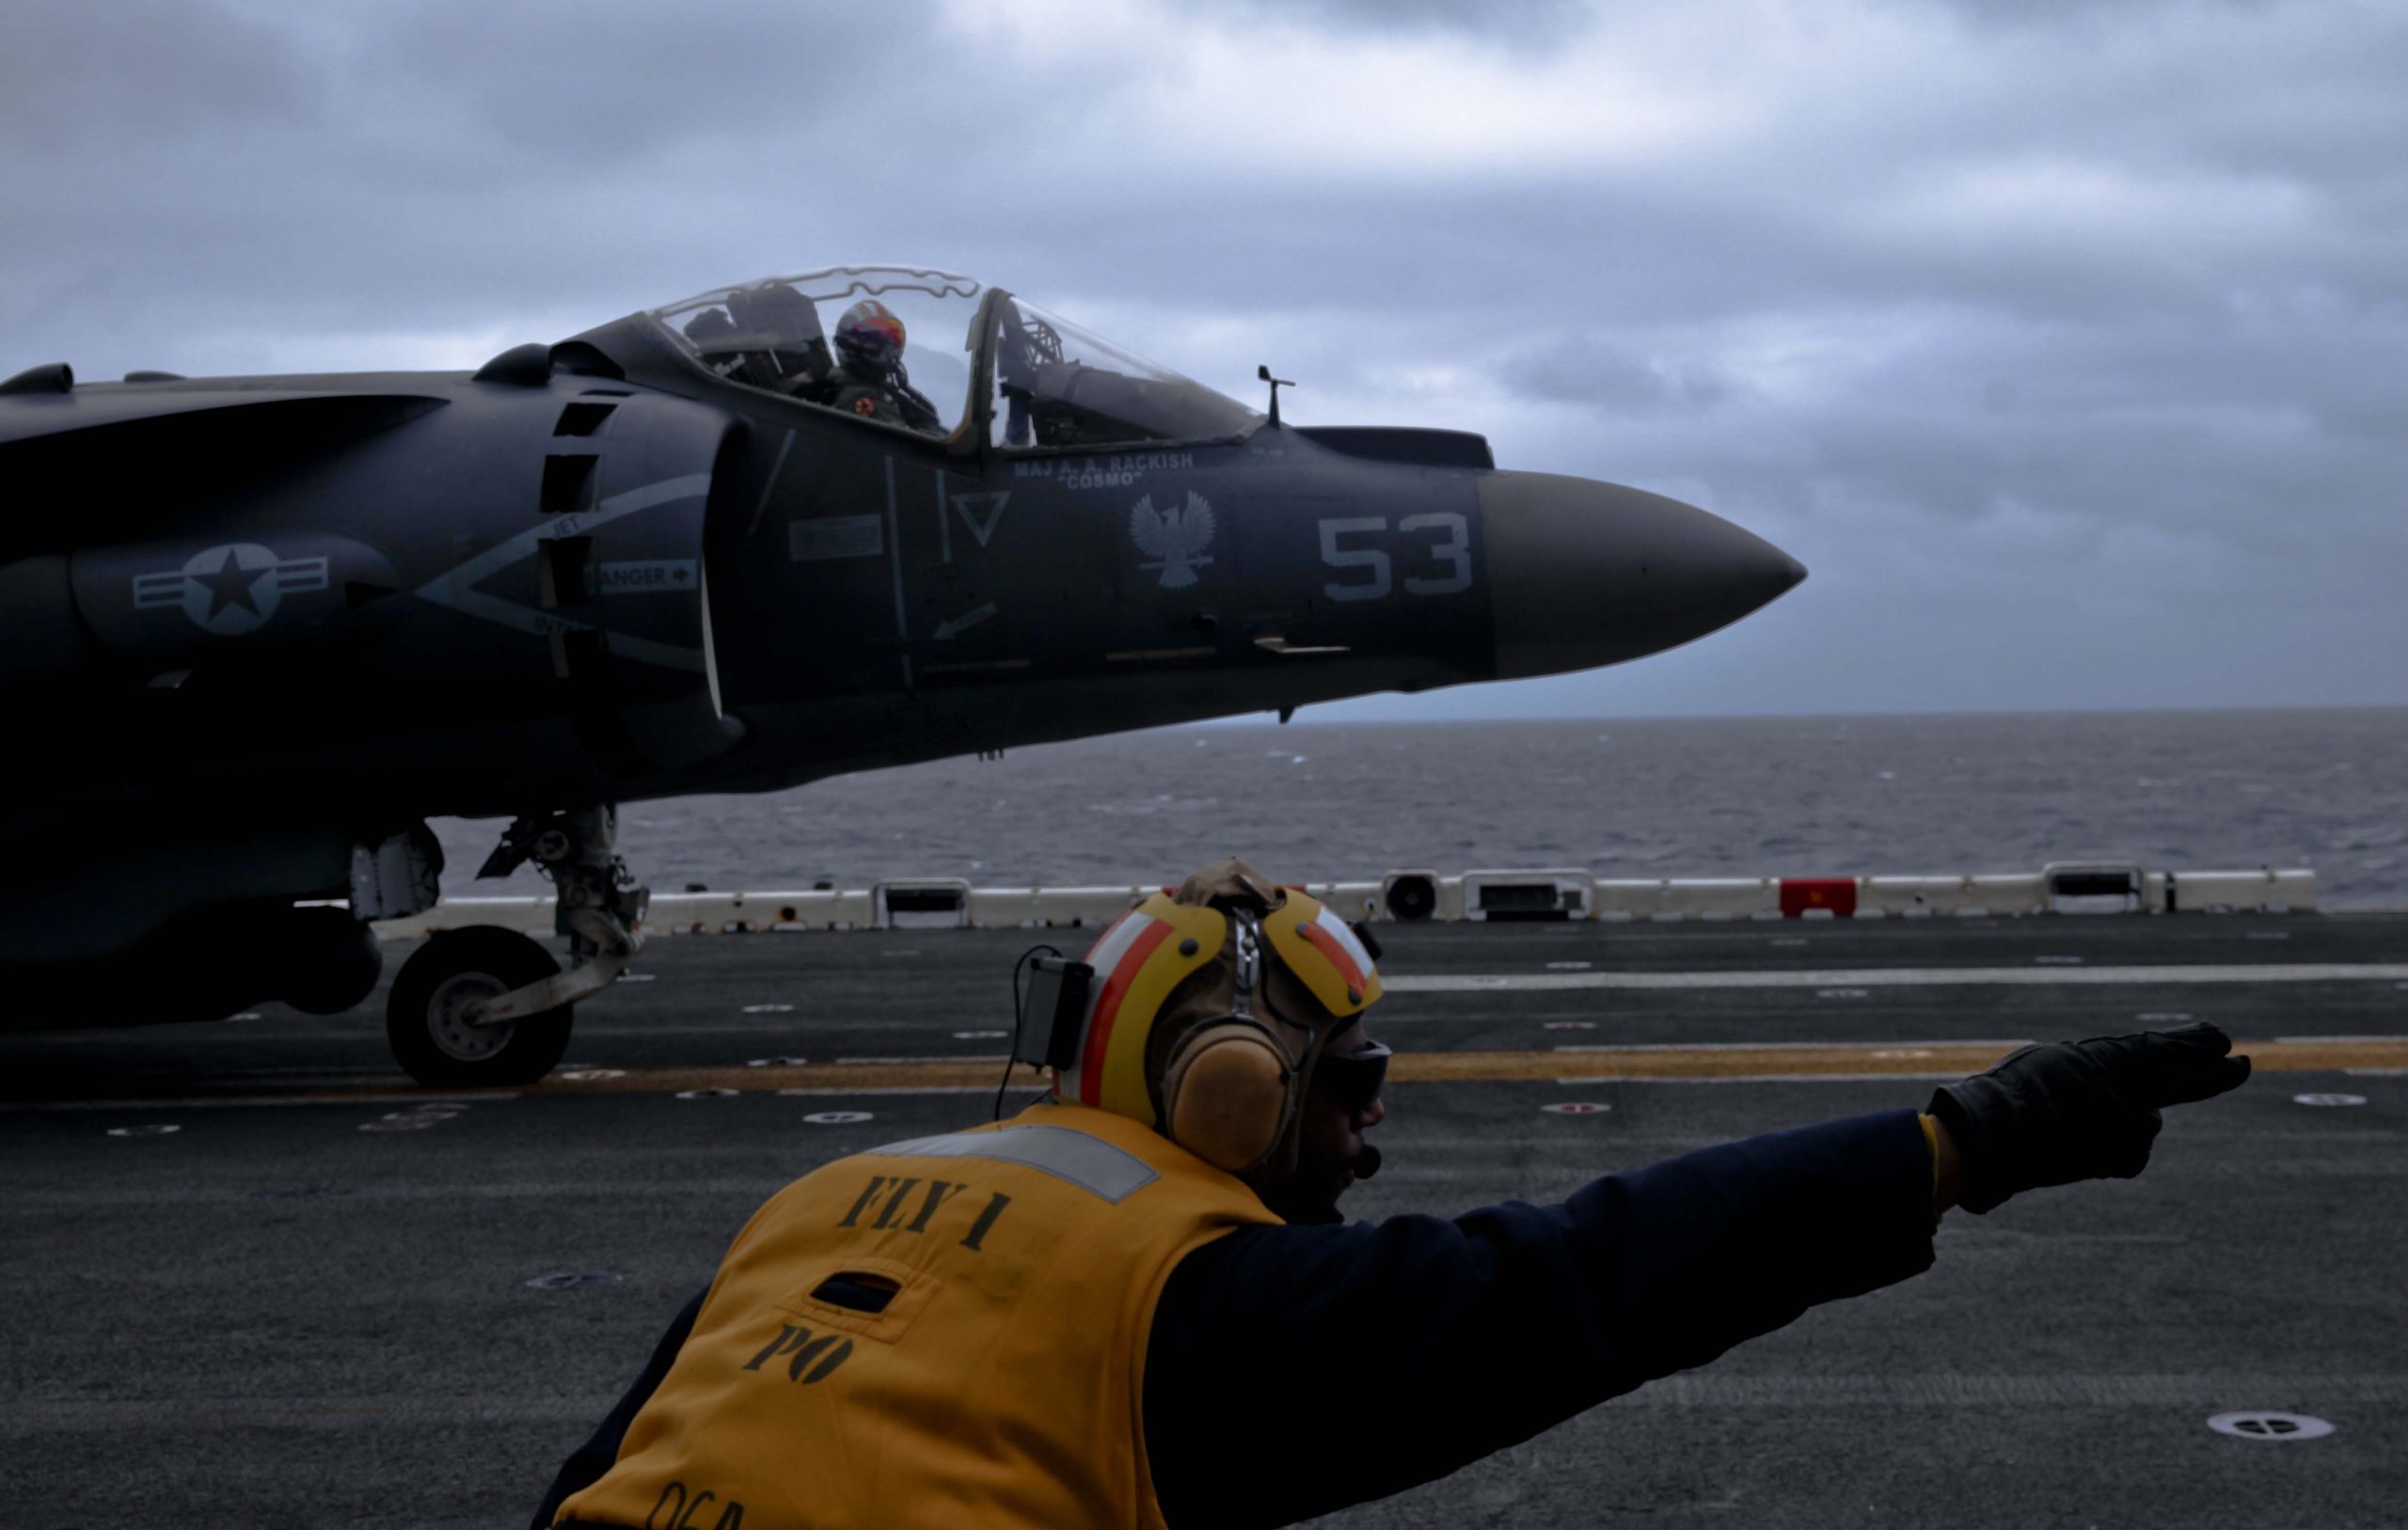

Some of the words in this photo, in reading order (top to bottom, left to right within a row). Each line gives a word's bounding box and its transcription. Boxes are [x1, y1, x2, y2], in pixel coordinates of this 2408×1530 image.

[1014, 460, 1053, 477] MAJ
[1318, 512, 1473, 602] 53
[836, 1176, 968, 1233] FLY
[741, 1324, 853, 1384] PO
